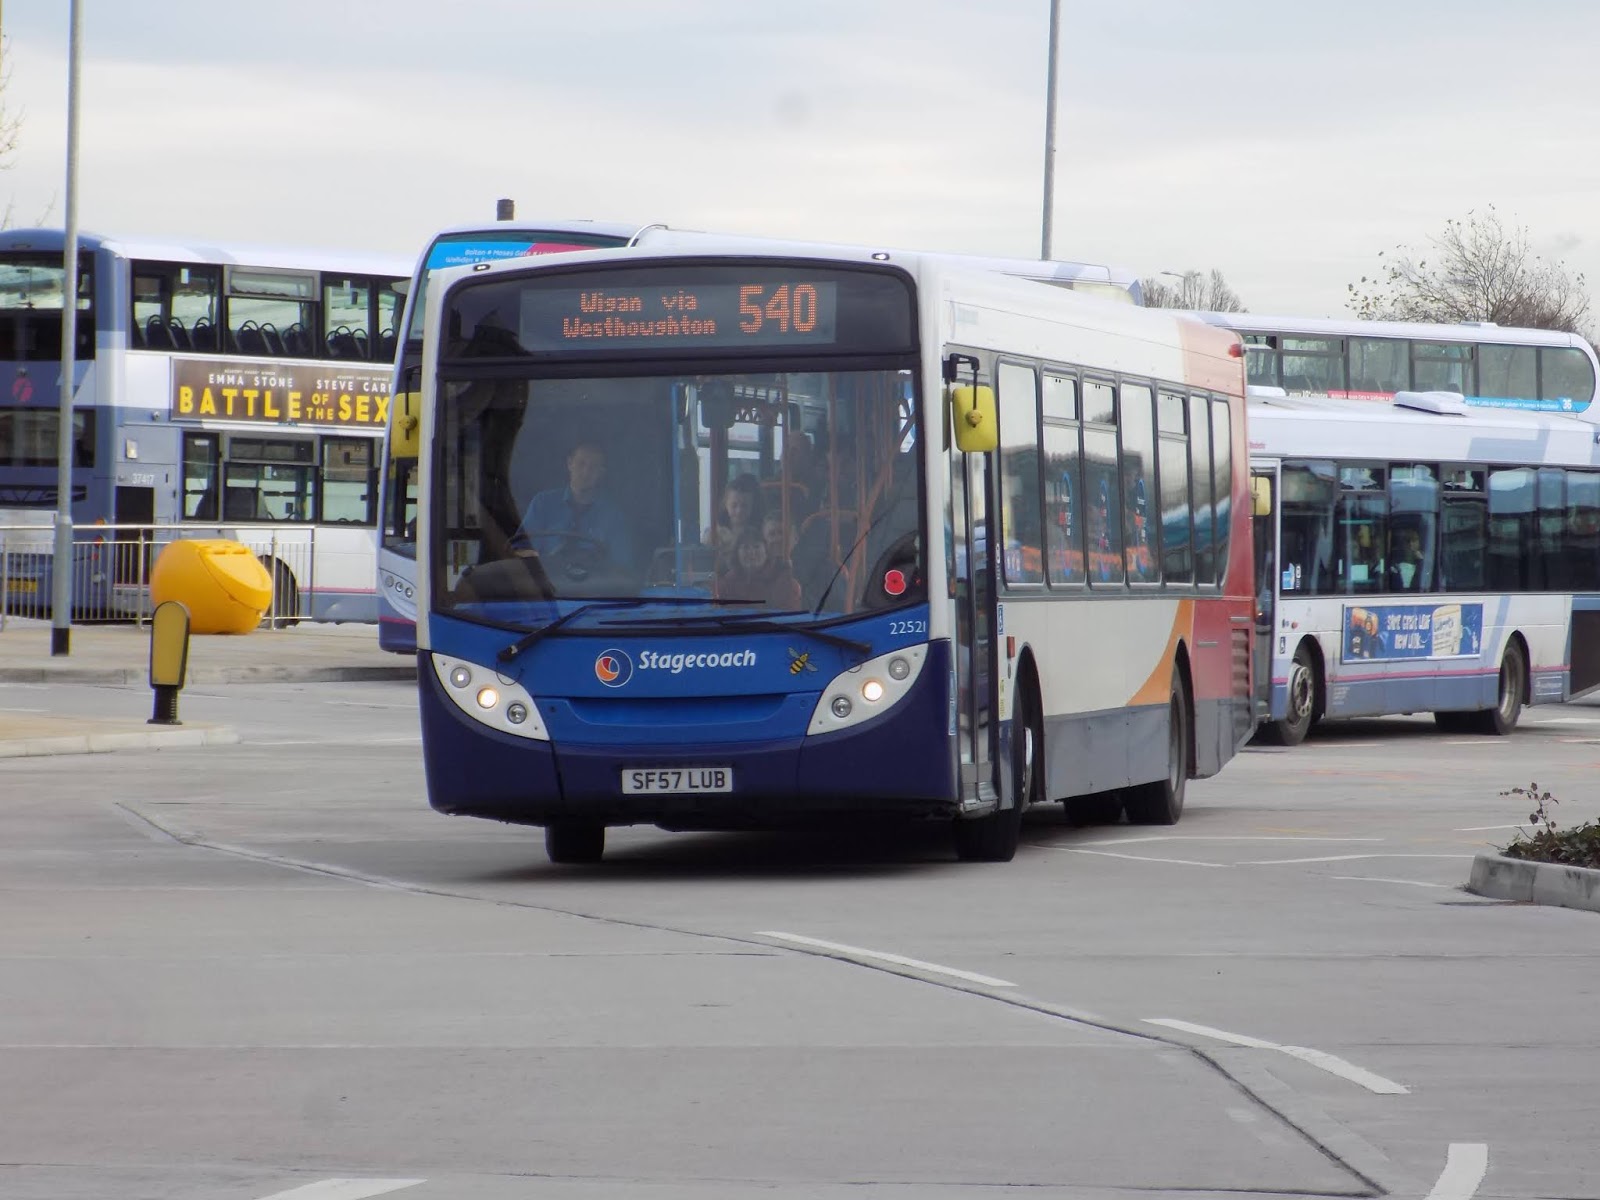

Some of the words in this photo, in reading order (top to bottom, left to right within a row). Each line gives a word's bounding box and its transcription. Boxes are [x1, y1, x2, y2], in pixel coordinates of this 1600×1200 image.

[661, 290, 697, 311] via
[739, 284, 817, 334] 540
[563, 315, 716, 338] Westhoughton
[208, 373, 244, 386] EMMA
[254, 376, 294, 388] STONE
[316, 379, 353, 391] STEVE
[179, 386, 301, 419] BATTLE
[311, 393, 329, 405] OF
[306, 407, 334, 421] THE
[889, 620, 926, 635] 22521
[638, 650, 756, 675] Stagecoach
[632, 770, 682, 790] SF57
[687, 770, 725, 790] LUB
